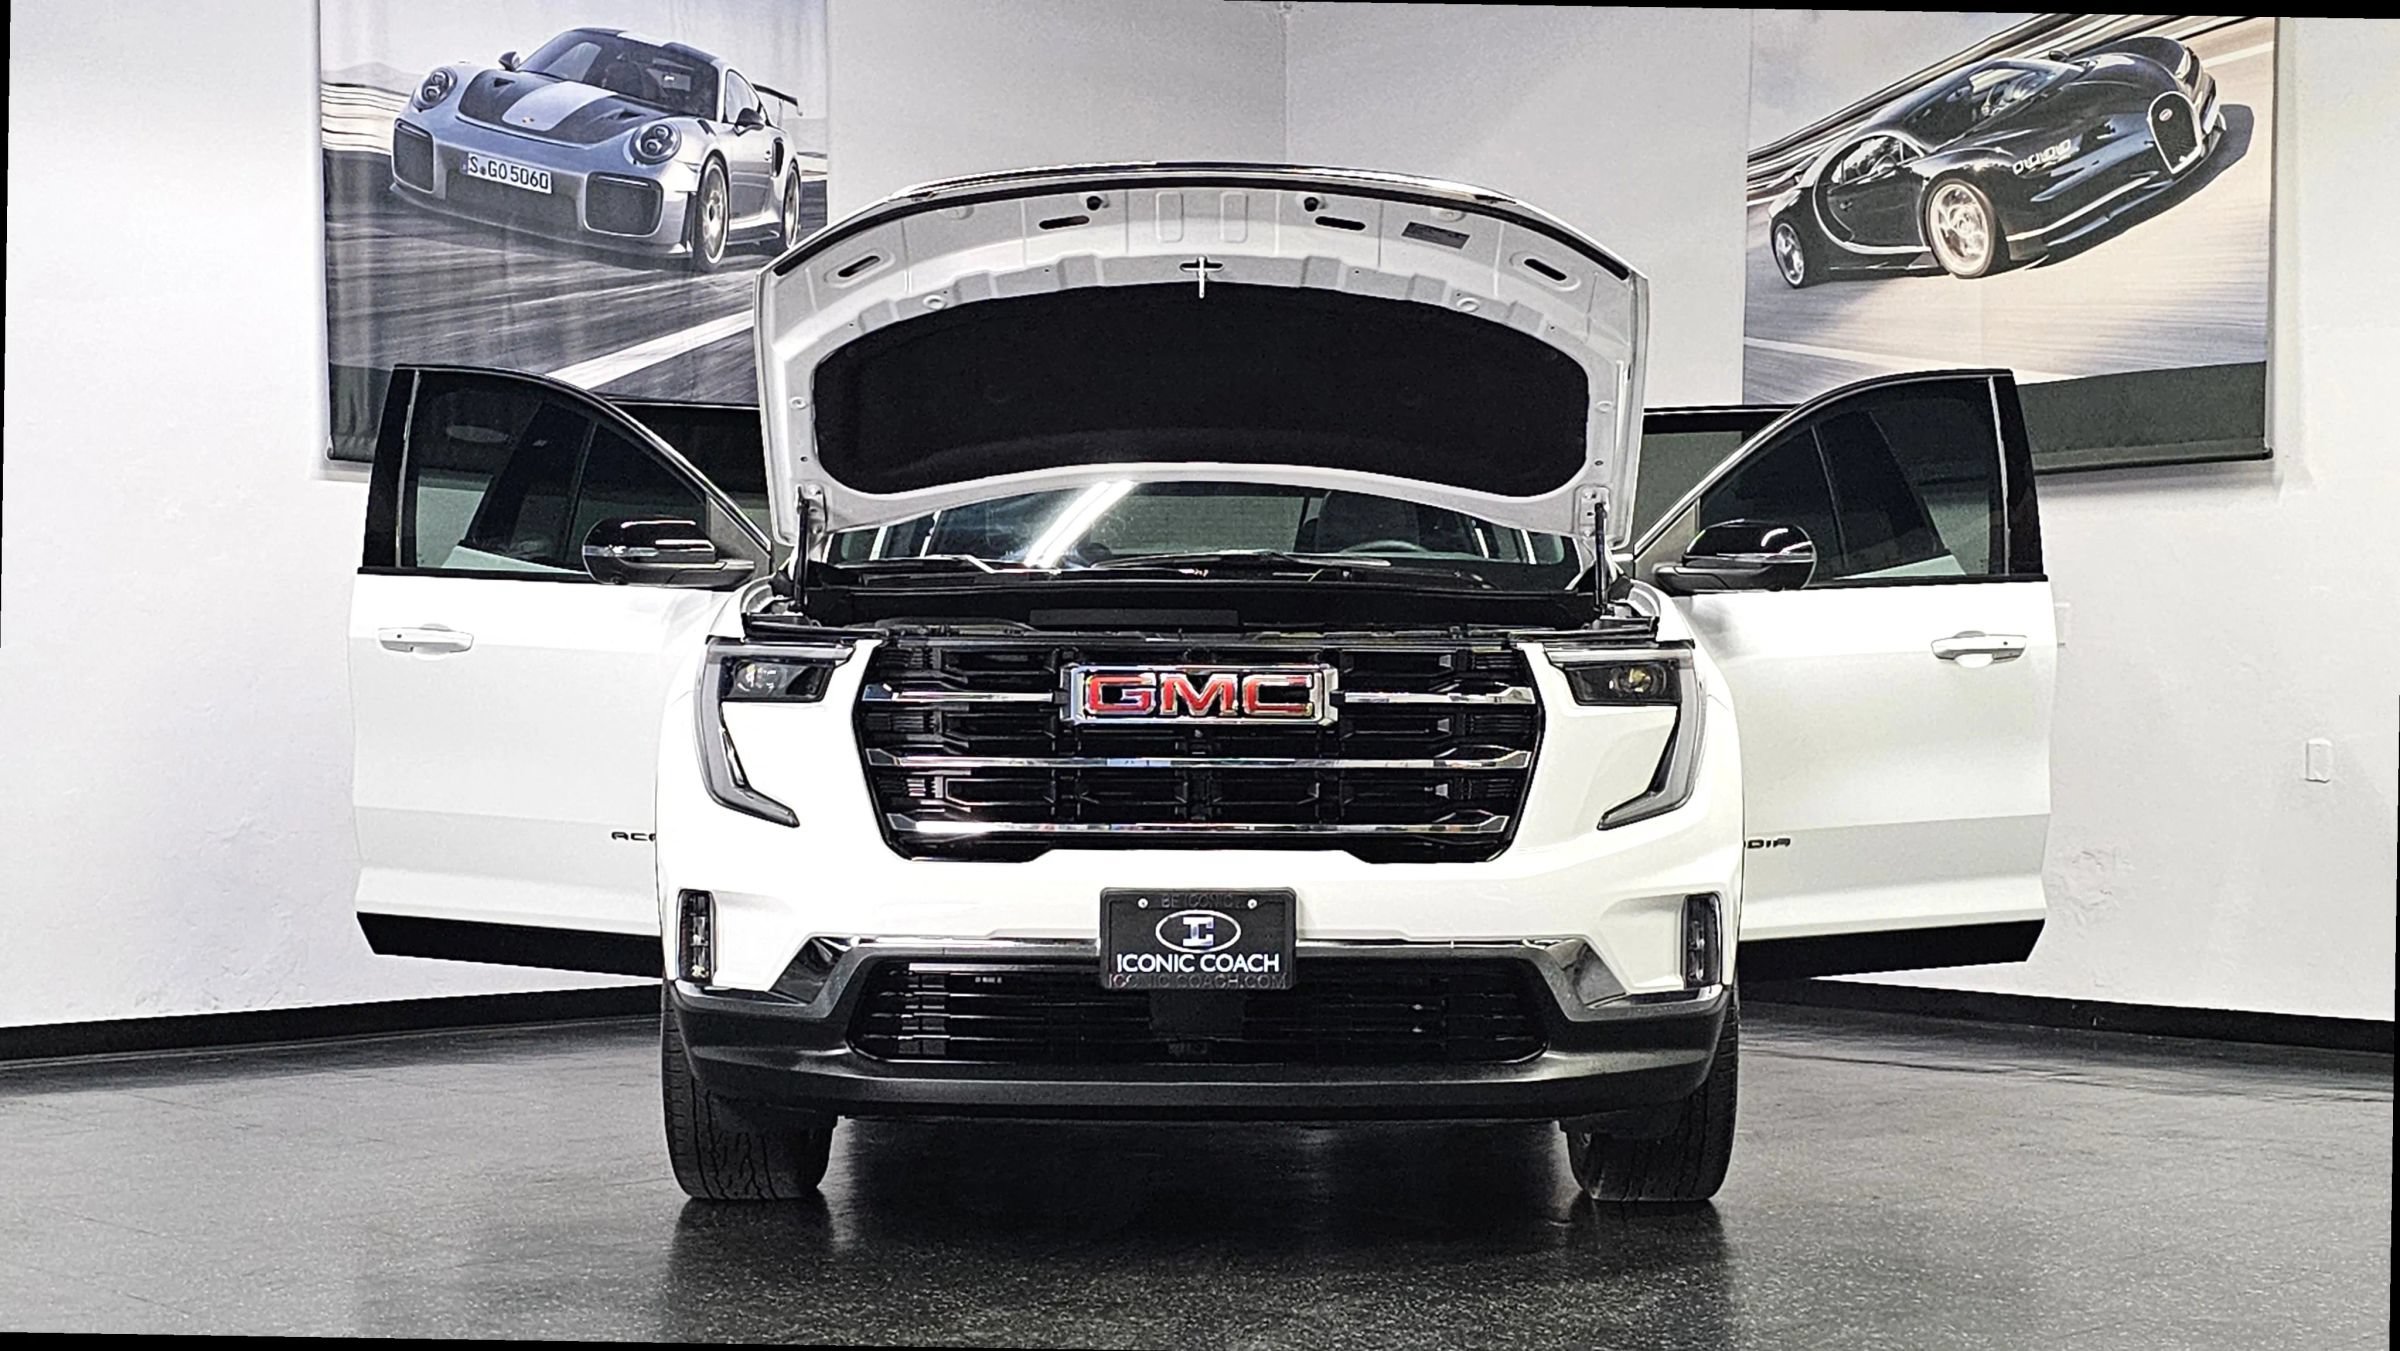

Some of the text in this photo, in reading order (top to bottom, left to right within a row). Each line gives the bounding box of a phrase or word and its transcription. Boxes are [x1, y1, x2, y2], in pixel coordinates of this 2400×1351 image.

[469, 156, 478, 174] S
[510, 165, 549, 190] 5060
[1085, 672, 1313, 717] GMC
[1116, 953, 1280, 973] ICONIC COACH
